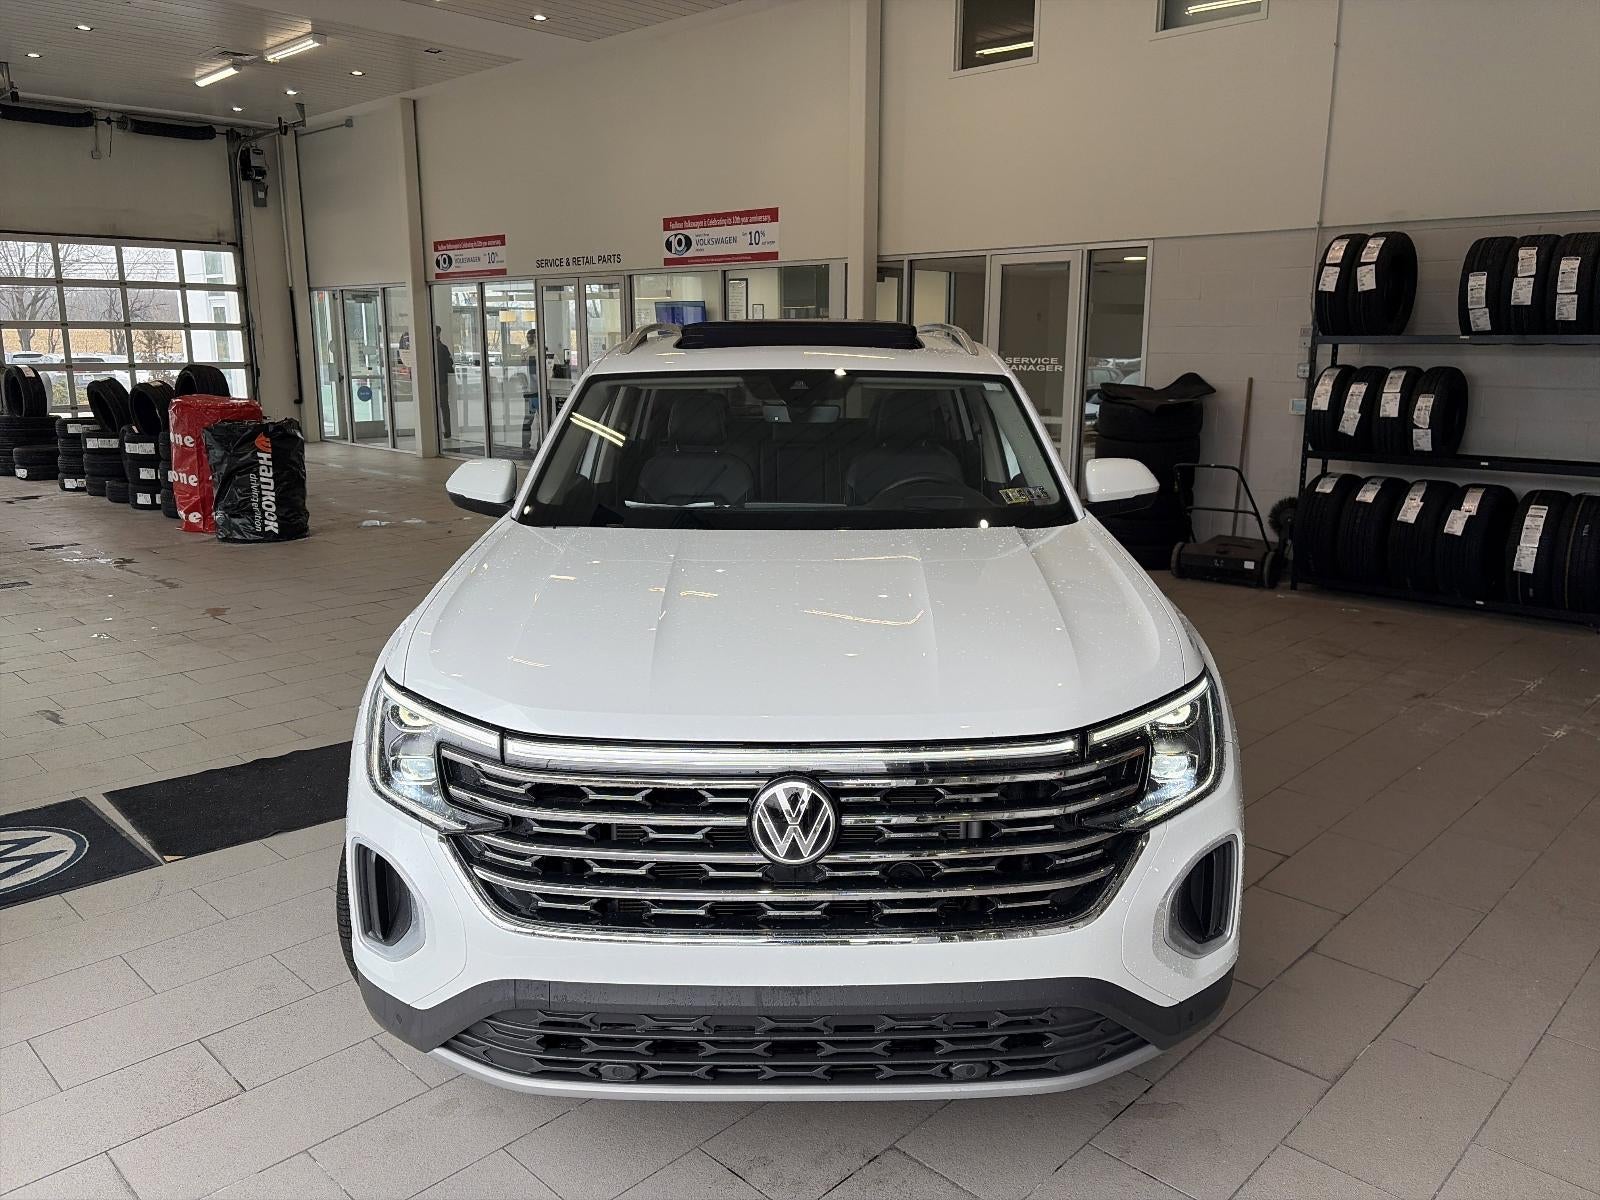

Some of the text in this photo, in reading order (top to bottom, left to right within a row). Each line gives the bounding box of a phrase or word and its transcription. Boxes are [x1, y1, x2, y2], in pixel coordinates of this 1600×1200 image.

[695, 236, 737, 246] VOLKSWAGEN
[536, 253, 622, 269] SERVICE & RETAIL PARTS
[1008, 364, 1063, 372] ANAGER
[249, 473, 260, 503] driving
